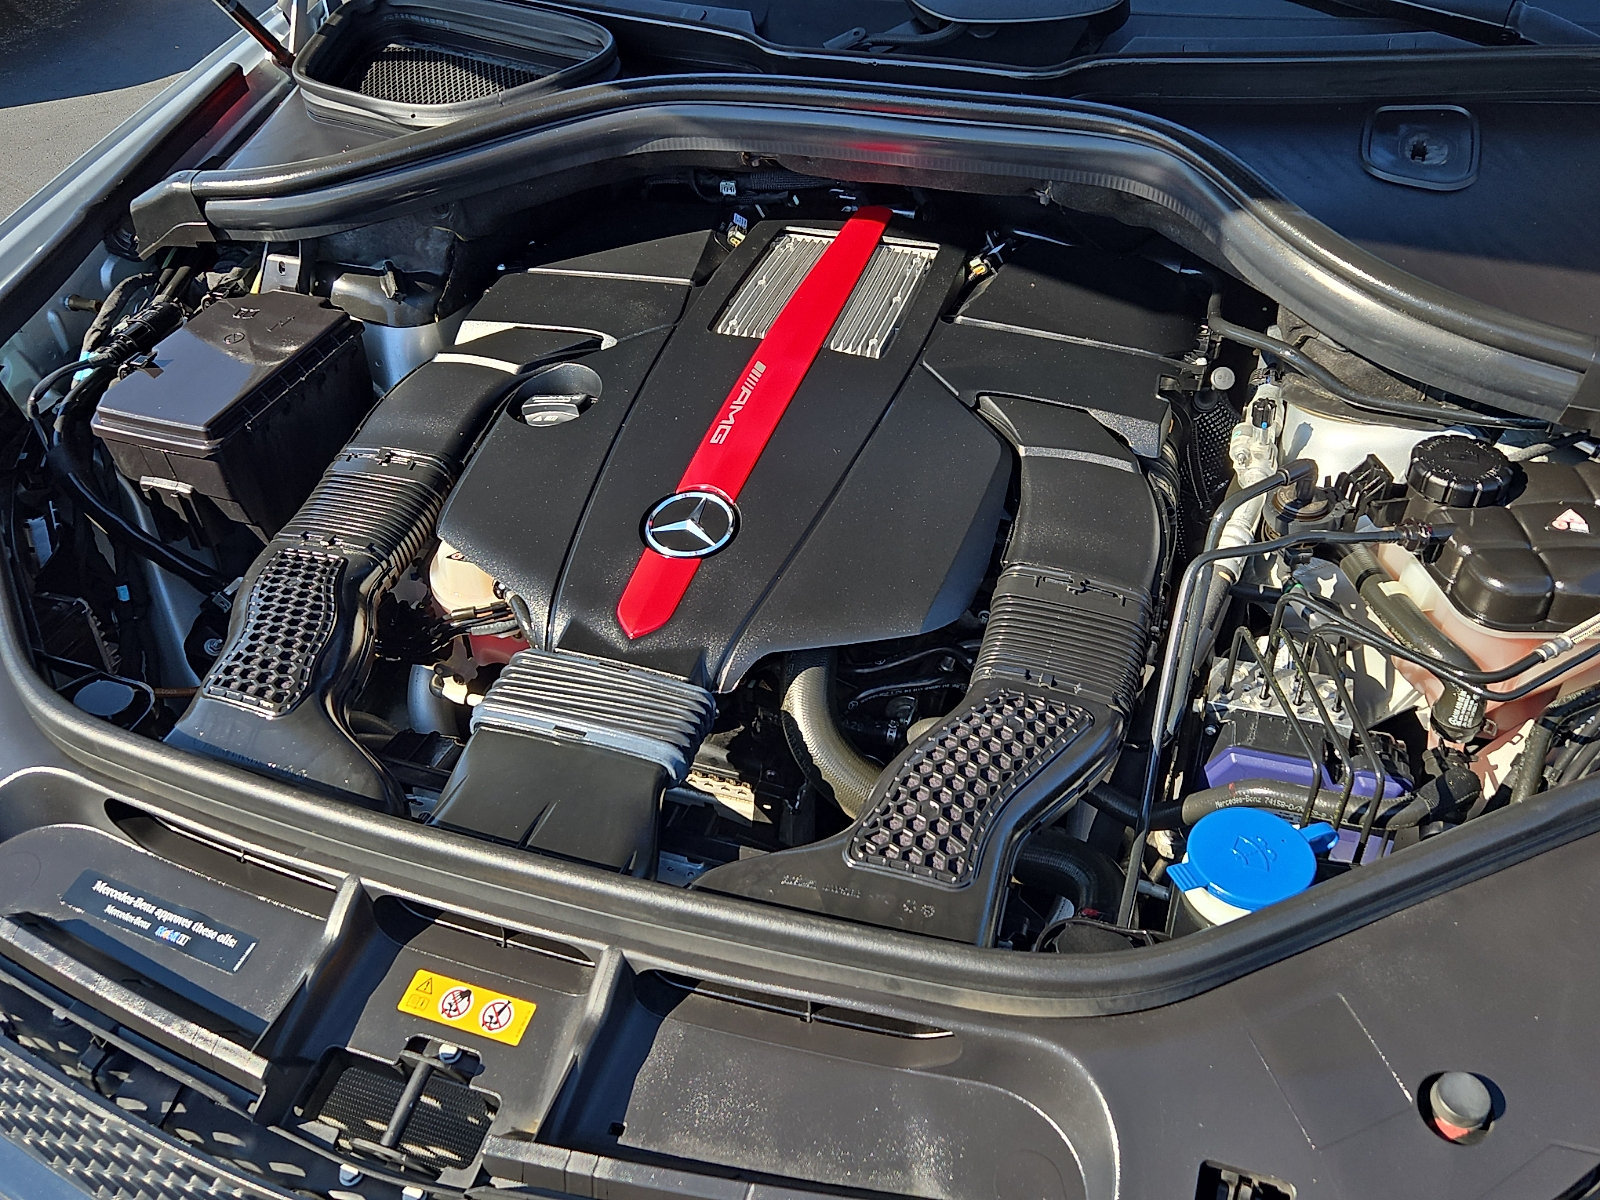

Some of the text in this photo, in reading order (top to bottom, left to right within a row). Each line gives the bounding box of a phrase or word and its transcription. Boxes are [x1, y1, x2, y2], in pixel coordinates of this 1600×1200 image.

[709, 385, 752, 445] AMG
[1215, 795, 1262, 809] Mercedes-Benz
[92, 880, 157, 915] Mercedes-Benz
[154, 908, 194, 930] approves
[191, 921, 218, 940] these
[104, 904, 152, 931] Mercedes-Benz
